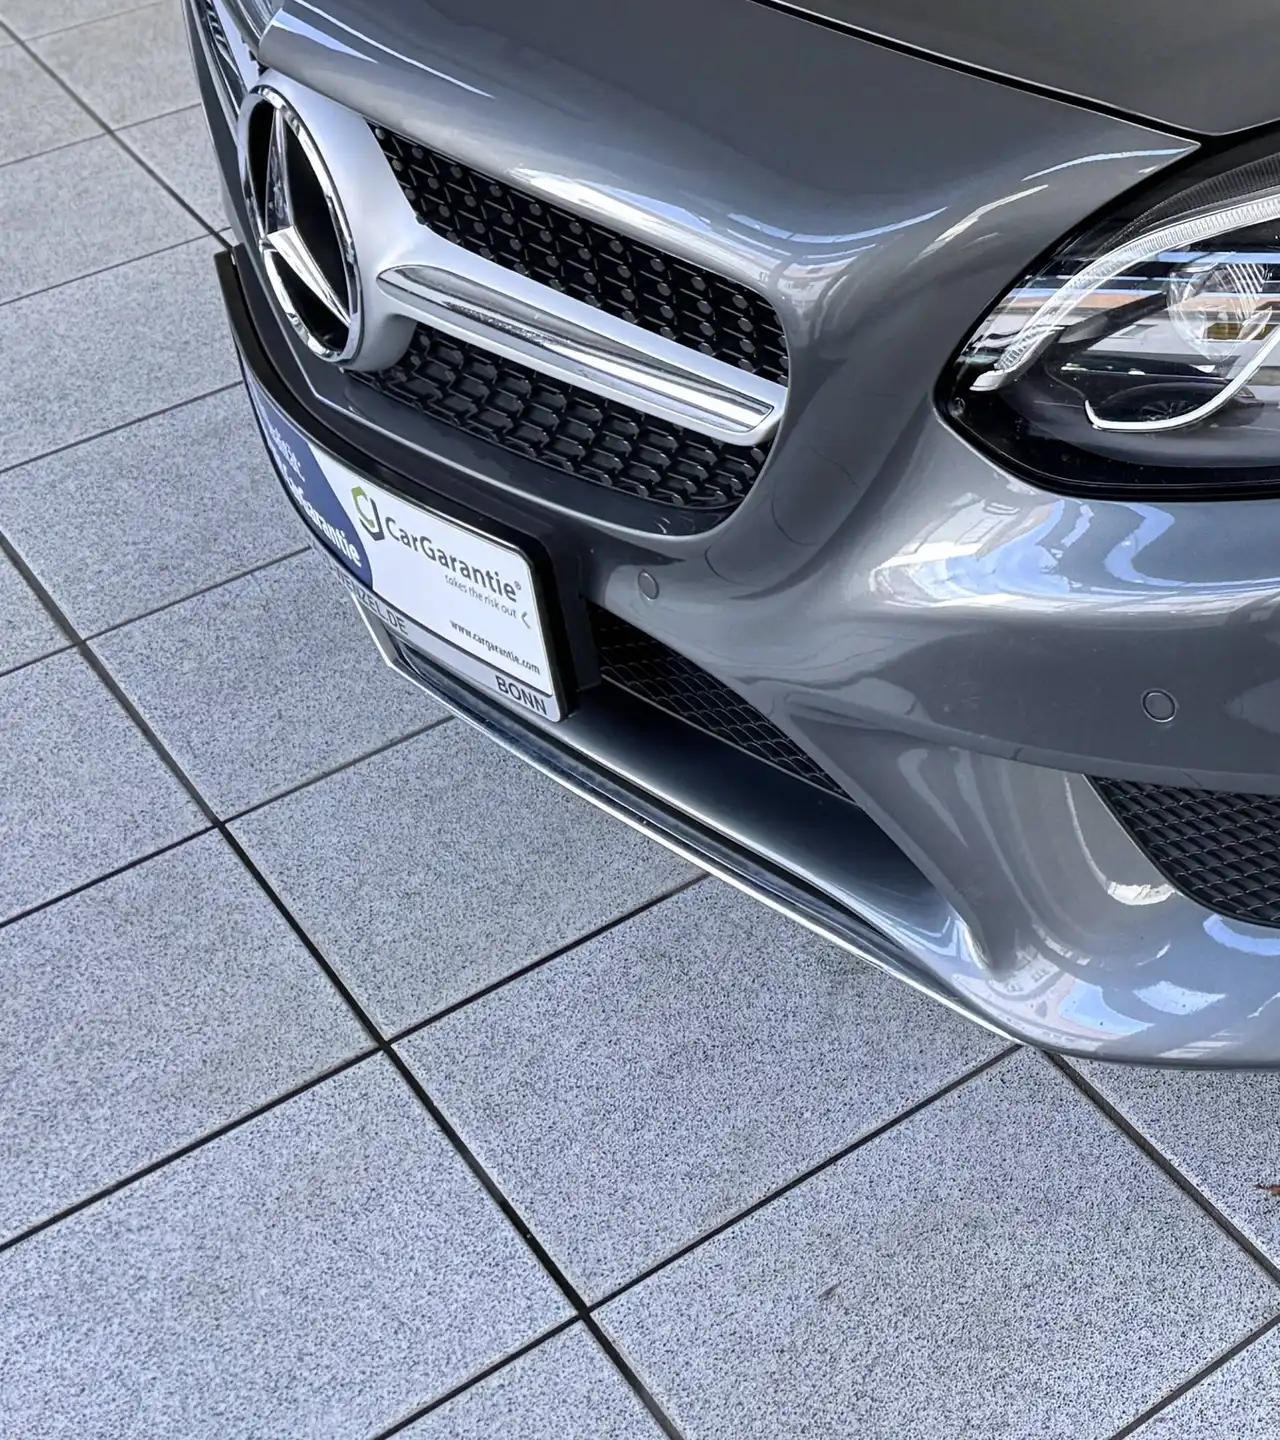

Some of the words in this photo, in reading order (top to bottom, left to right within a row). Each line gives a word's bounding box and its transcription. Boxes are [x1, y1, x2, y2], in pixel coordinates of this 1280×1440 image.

[444, 574, 468, 594] takes
[469, 587, 483, 602] the
[484, 595, 500, 611] risk
[500, 604, 517, 619] out
[449, 620, 541, 675] www.cargarantie.com
[495, 675, 548, 715] BONN
